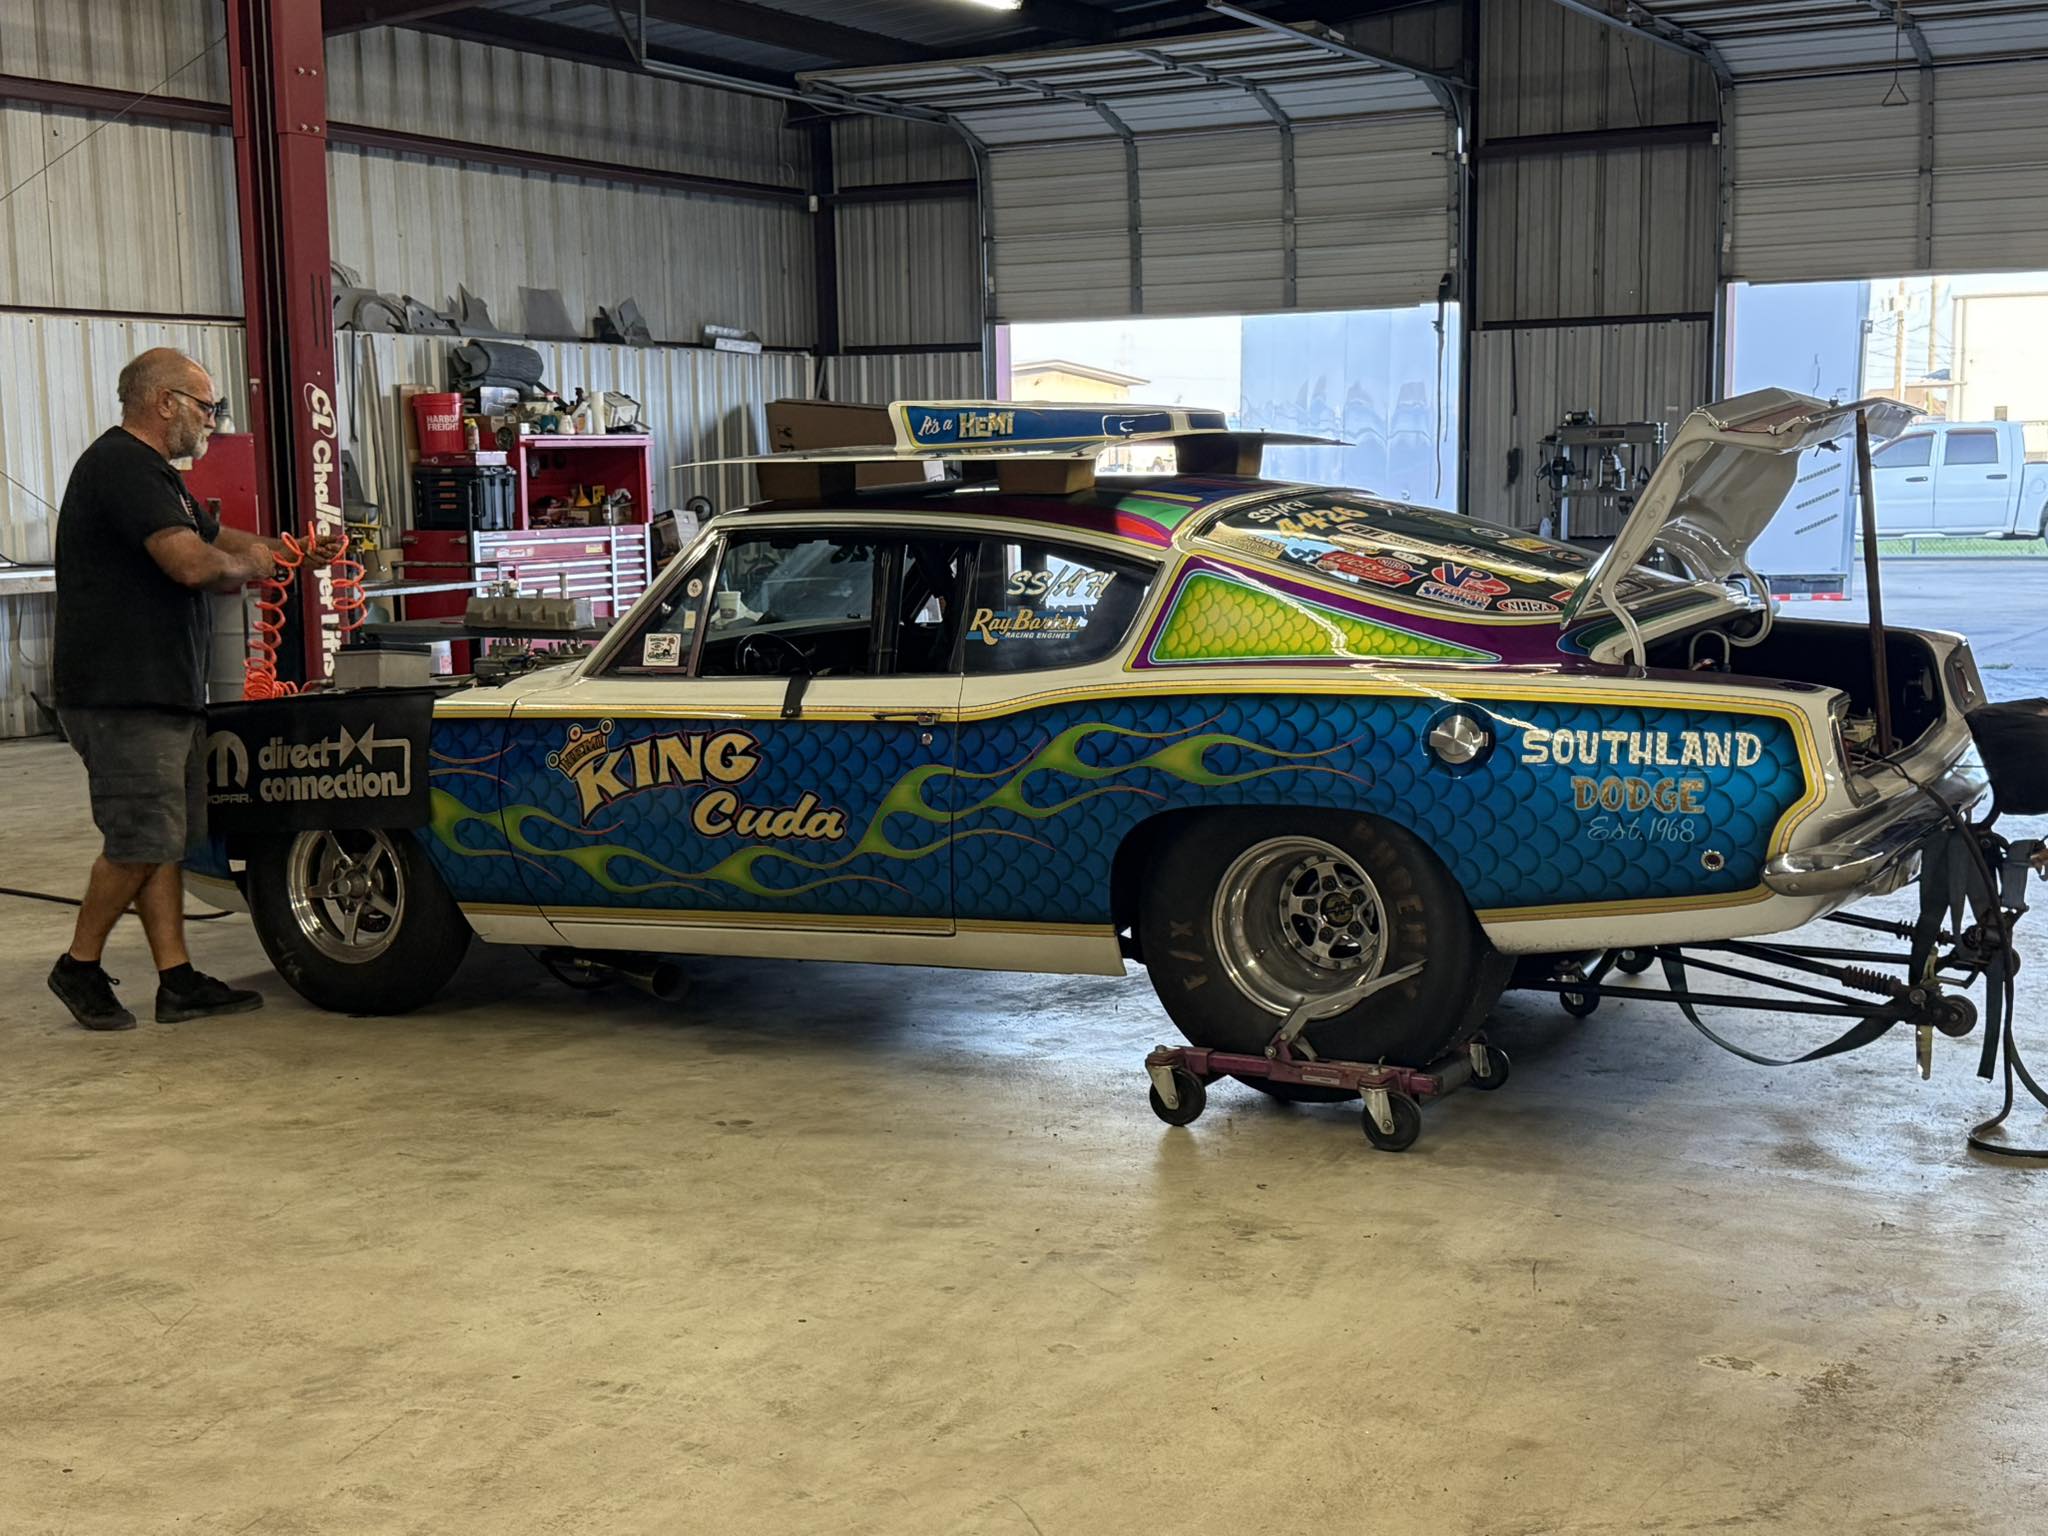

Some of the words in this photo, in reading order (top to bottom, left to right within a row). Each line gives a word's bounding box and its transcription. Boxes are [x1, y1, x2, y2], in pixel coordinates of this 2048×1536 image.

[427, 423, 459, 431] FREIGHT
[918, 415, 941, 437] It's
[943, 417, 953, 431] a
[958, 411, 1016, 439] HEMI
[1276, 506, 1370, 538] 4426
[1329, 554, 1377, 571] LUCAS
[1379, 566, 1406, 579] OIL
[1441, 562, 1493, 588] VP
[1006, 565, 1118, 604] SS/AH
[1508, 601, 1552, 612] NHRA
[970, 608, 1013, 646] Ray
[1004, 632, 1034, 640] RACING
[1036, 632, 1072, 640] ENGINES
[258, 736, 330, 771] direct
[1521, 728, 1762, 767] SOUTHLAND
[260, 764, 404, 802] connection
[576, 731, 760, 825] KING
[1571, 775, 1705, 814] DODGE
[691, 788, 846, 840] Cuda
[1587, 817, 1644, 841] Est.
[1649, 818, 1696, 843] 1968
